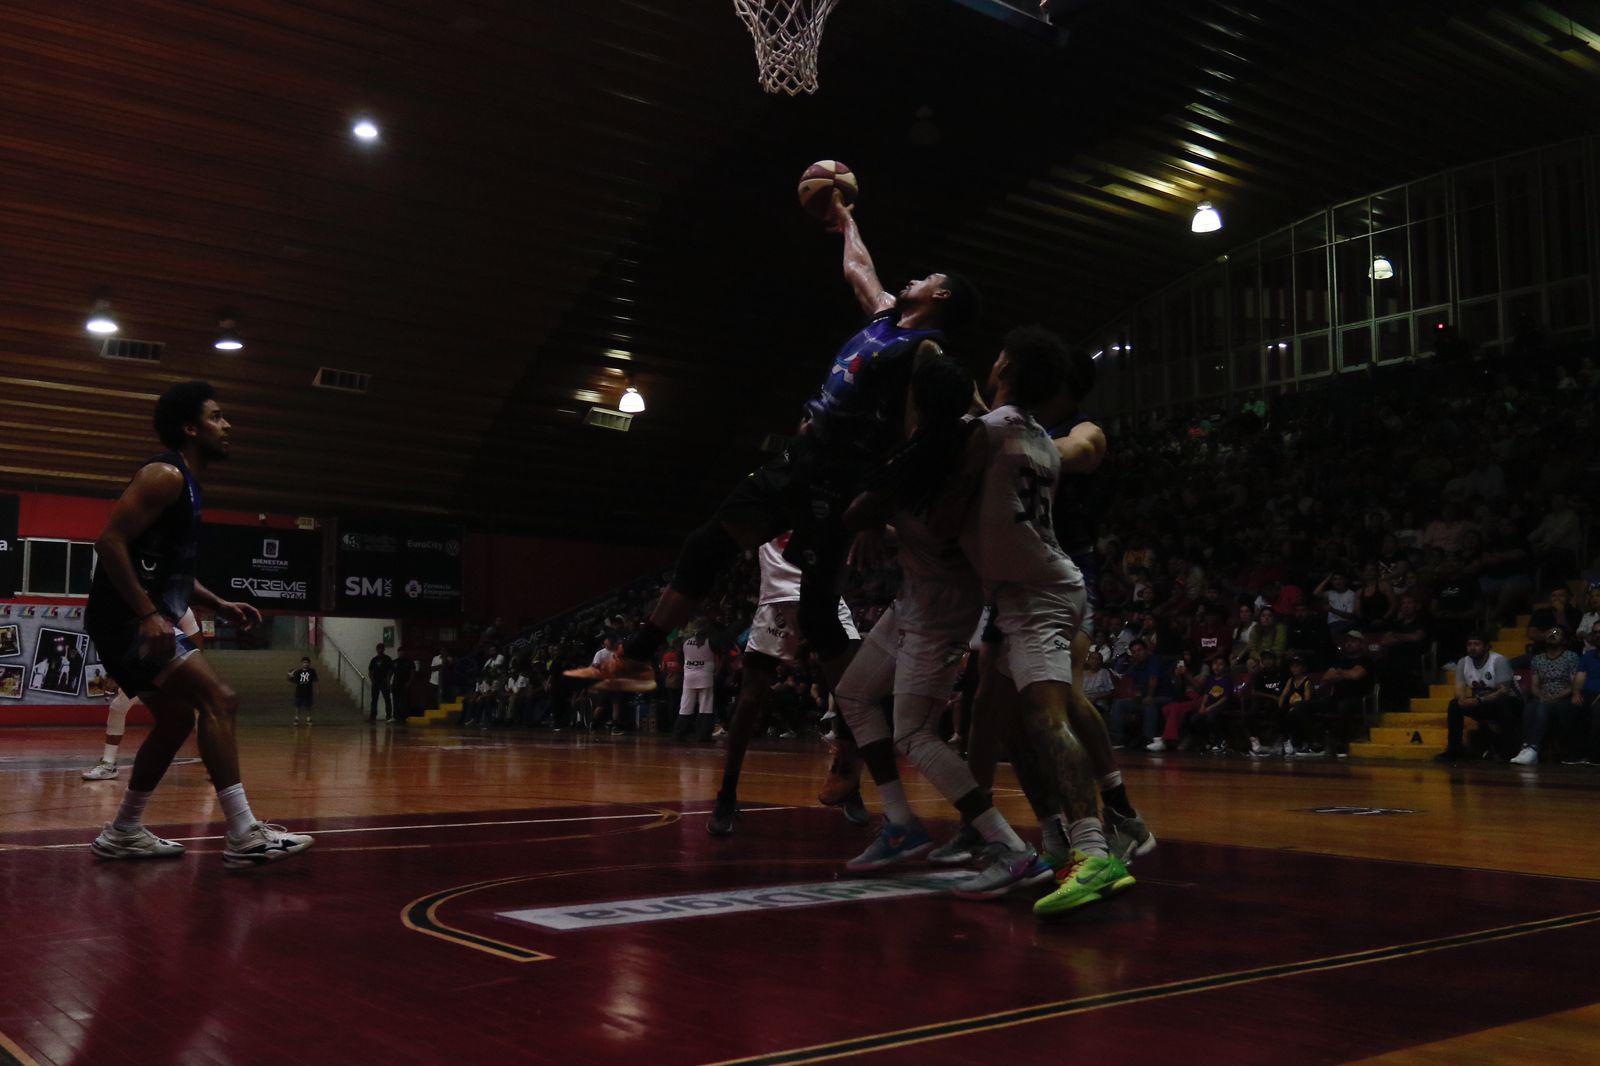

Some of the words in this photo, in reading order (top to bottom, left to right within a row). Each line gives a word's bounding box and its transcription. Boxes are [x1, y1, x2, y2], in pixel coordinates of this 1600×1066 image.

[252, 558, 289, 567] BIENESTAR
[231, 577, 307, 593] EXTREME
[344, 576, 384, 597] SM
[1411, 731, 1422, 744] A
